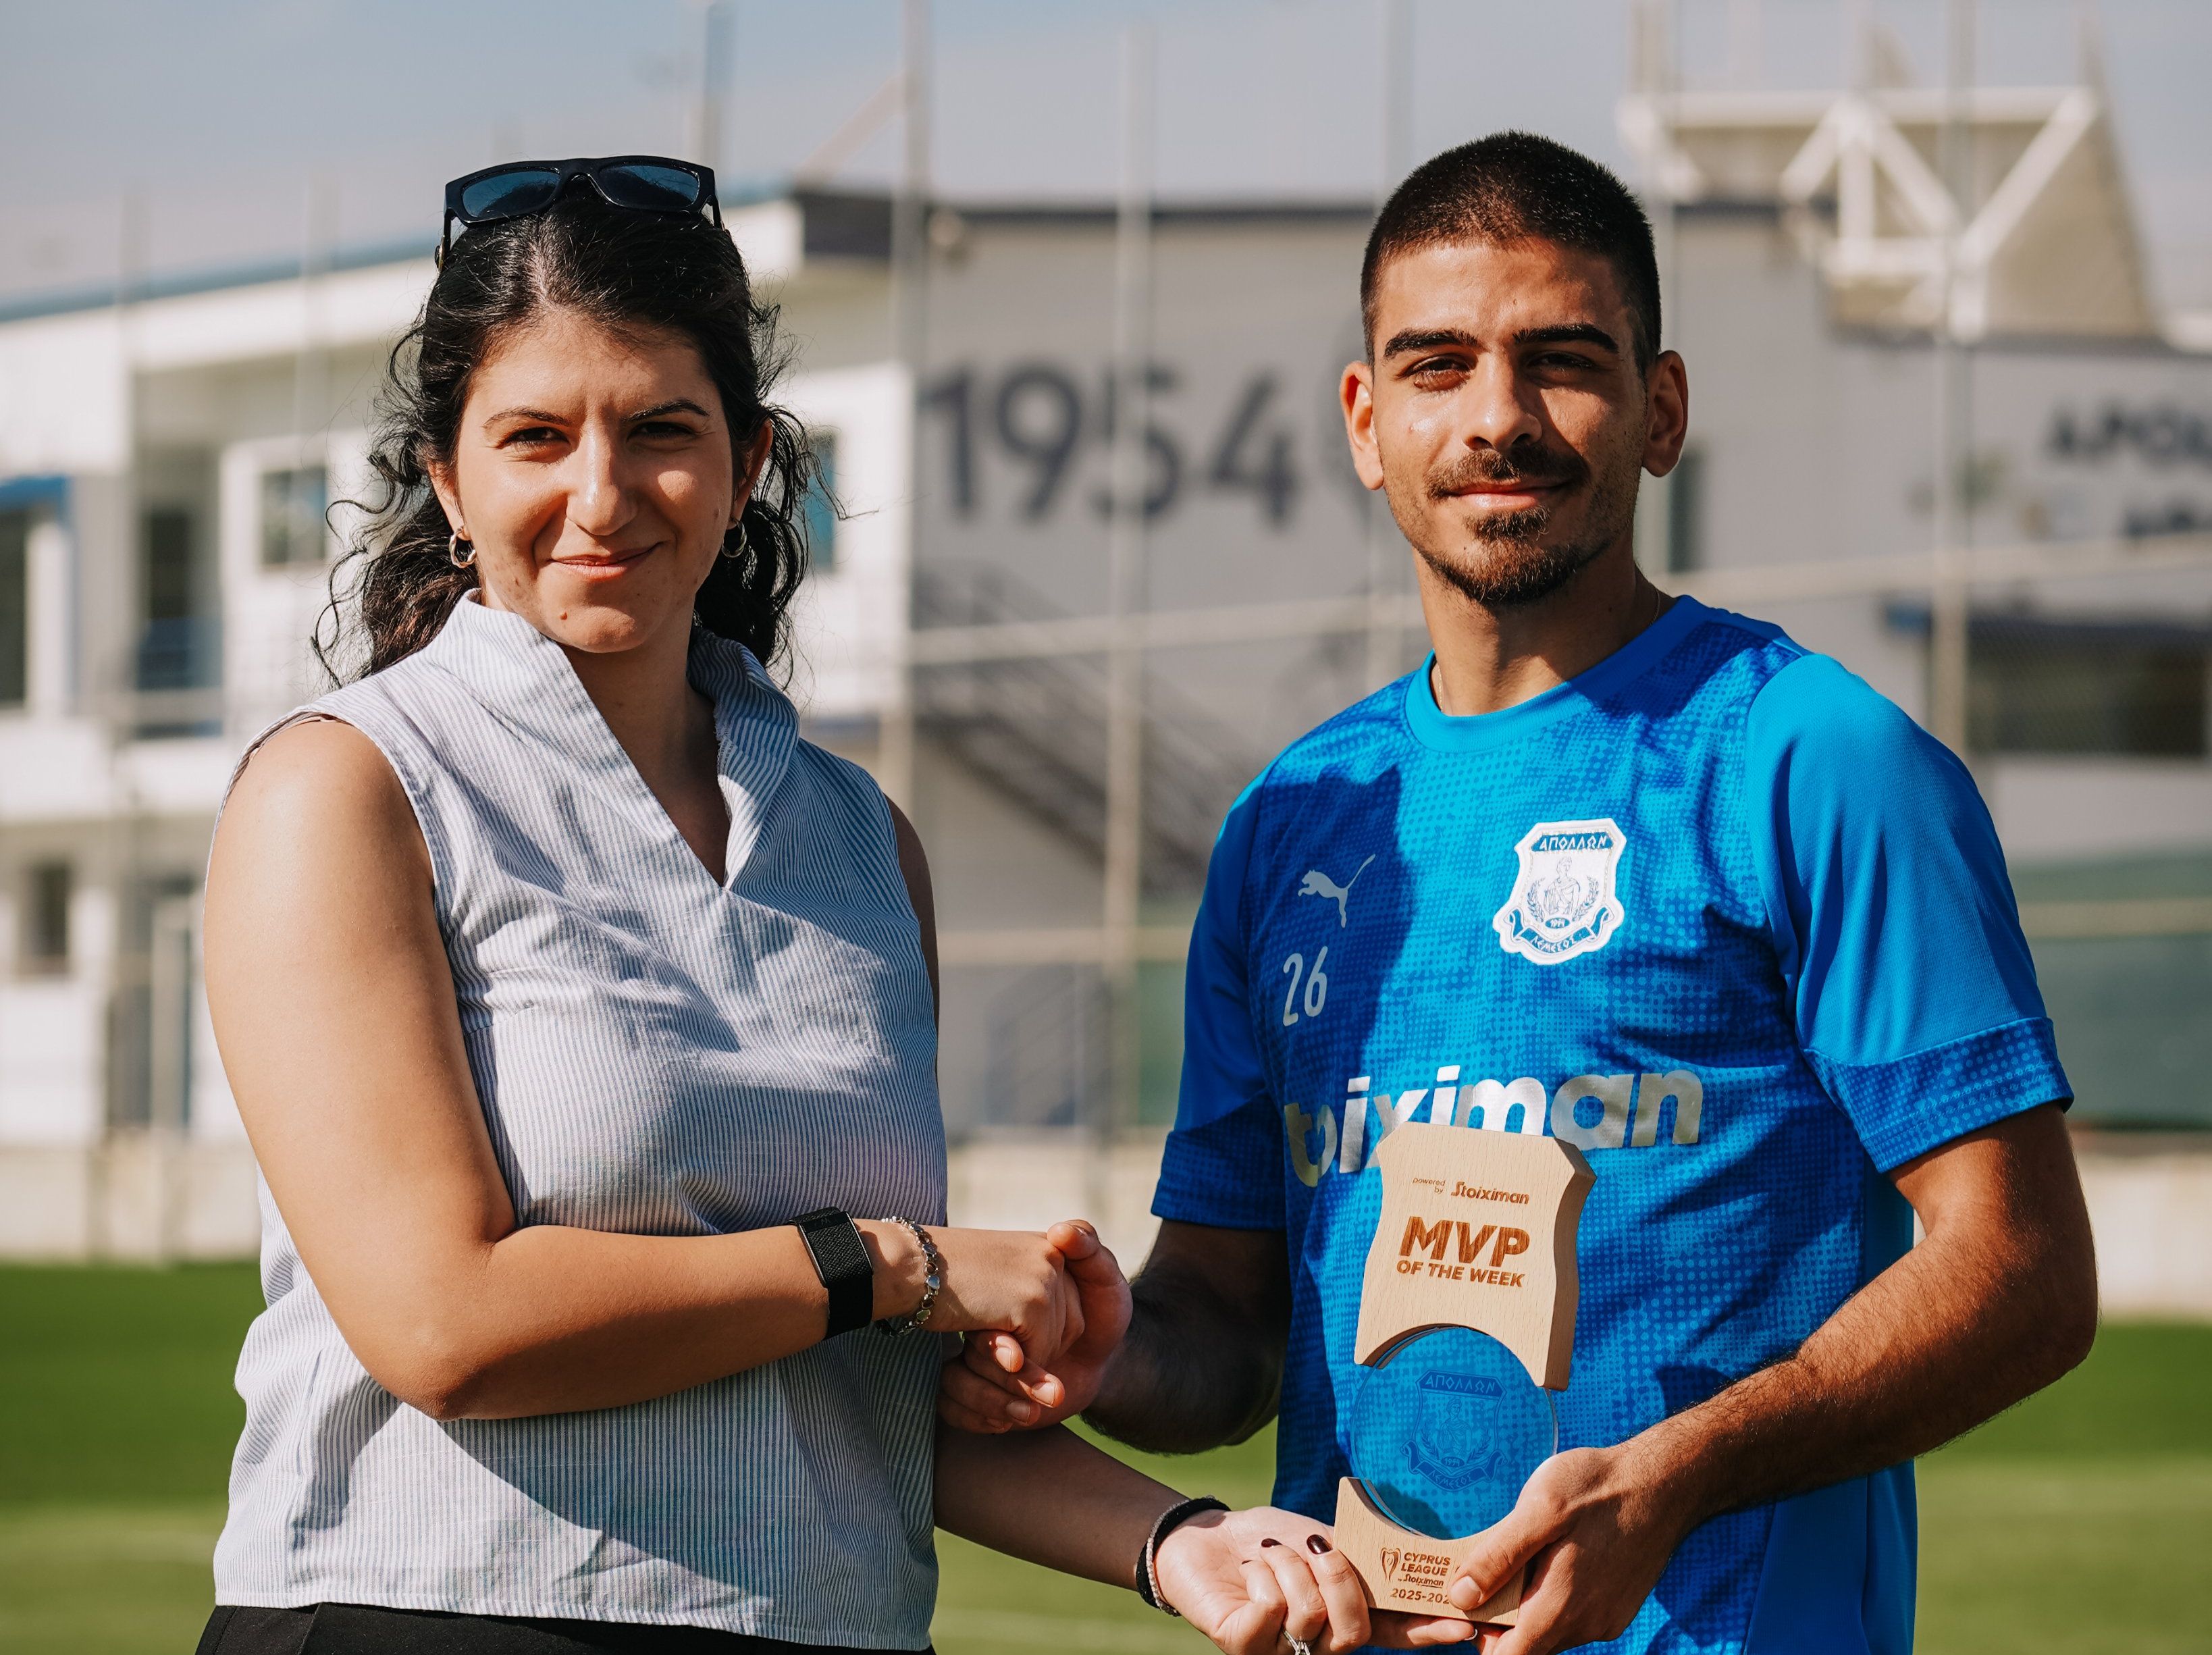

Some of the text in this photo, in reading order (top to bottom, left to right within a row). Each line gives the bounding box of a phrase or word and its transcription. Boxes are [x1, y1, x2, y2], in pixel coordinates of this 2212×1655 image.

[920, 363, 1296, 528] 1954
[1283, 945, 1329, 1027] 26
[1412, 1177, 1446, 1194] powered by
[1450, 1180, 1531, 1205] Stoiximan
[1398, 1215, 1531, 1267] MVP
[1396, 1259, 1527, 1288] OF THE WEEK
[1400, 1562, 1448, 1577] LEAGUE
[1404, 1552, 1451, 1567] CYPRUS
[1390, 1587, 1450, 1605] 2025-202
